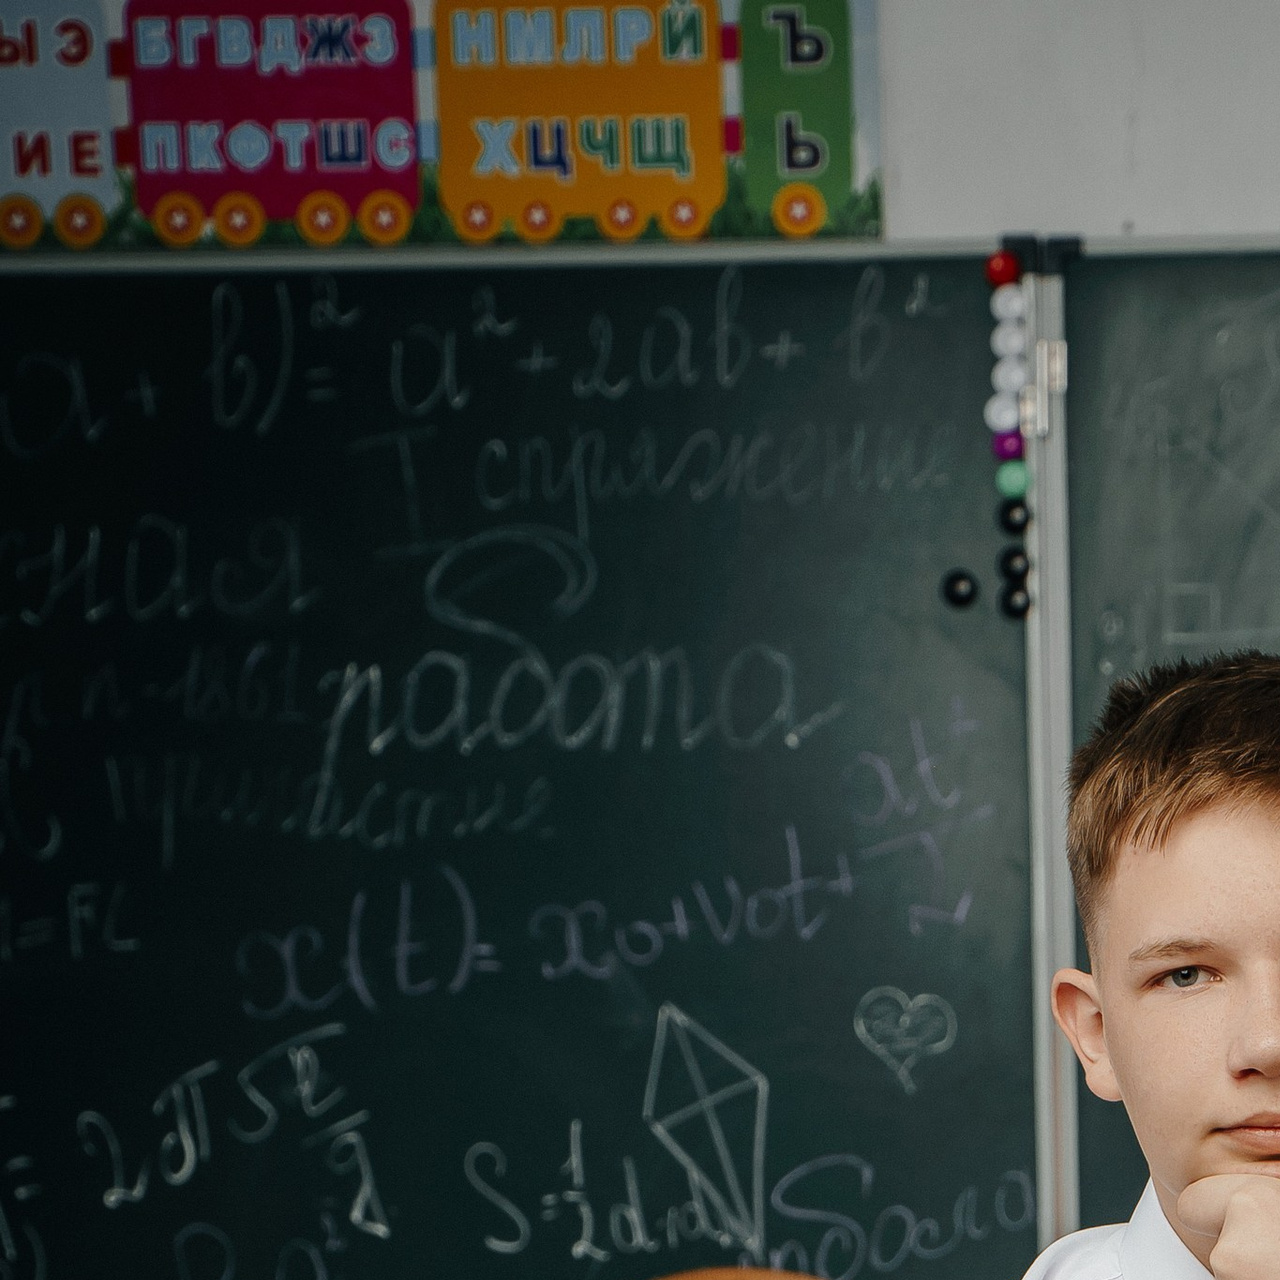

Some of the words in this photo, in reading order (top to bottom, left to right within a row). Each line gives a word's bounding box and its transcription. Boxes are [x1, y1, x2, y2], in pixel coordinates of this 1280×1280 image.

[770, 10, 826, 66] Ъ
[474, 117, 692, 180] ХЦЧЩ
[308, 526, 848, 842] работа
